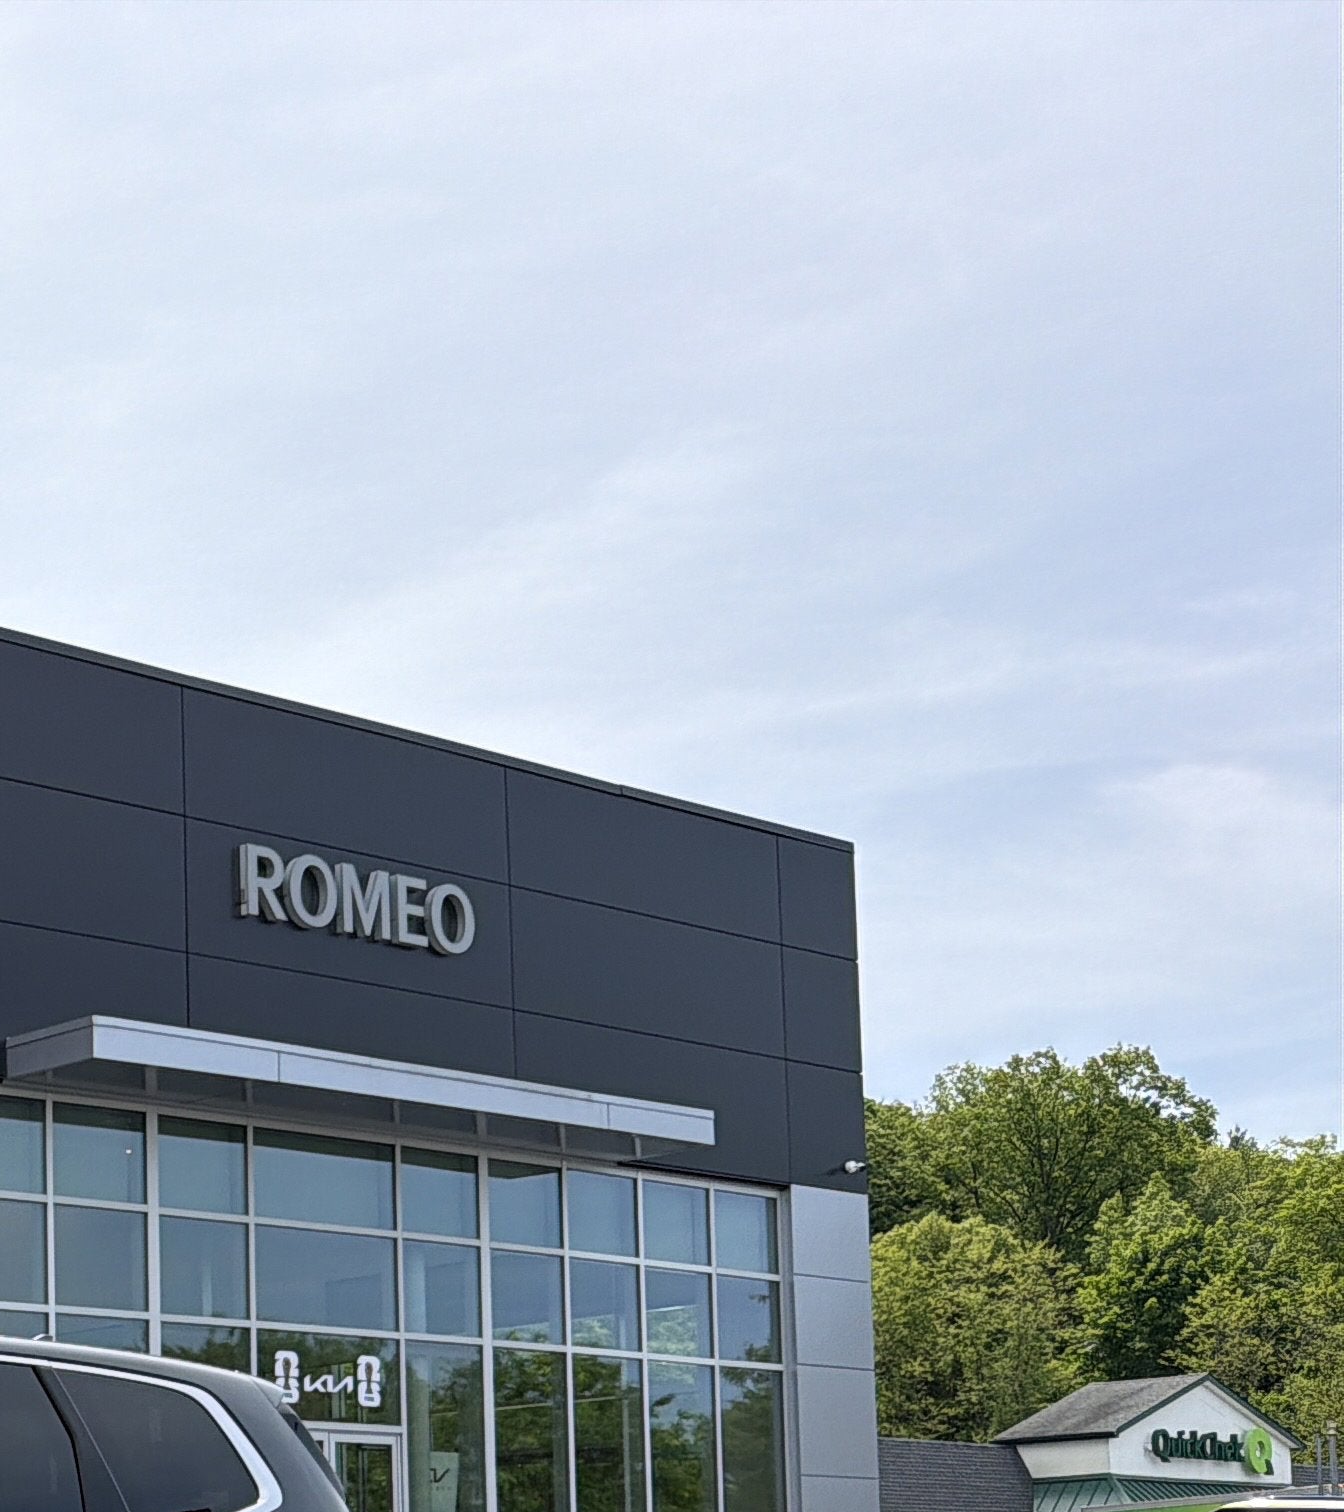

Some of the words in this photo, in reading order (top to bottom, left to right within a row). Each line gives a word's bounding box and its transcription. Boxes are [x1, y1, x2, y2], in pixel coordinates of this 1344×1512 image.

[239, 843, 476, 955] ROMEO
[303, 1374, 354, 1394] KIA
[1151, 1428, 1245, 1462] QuickChek
